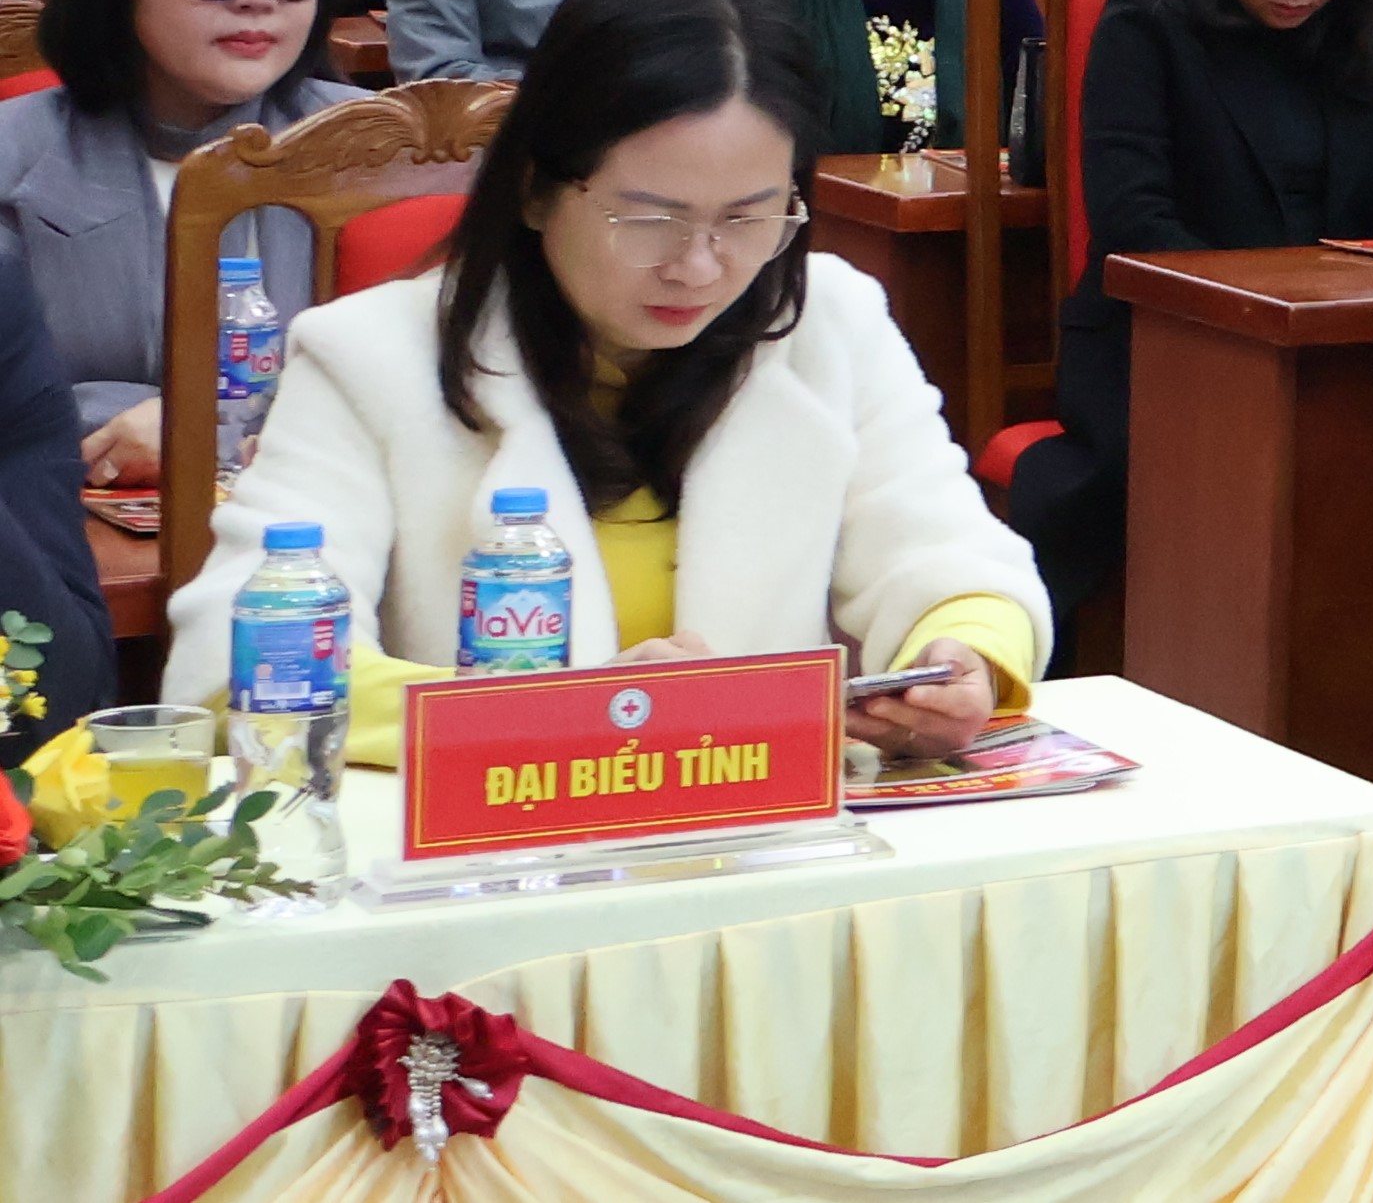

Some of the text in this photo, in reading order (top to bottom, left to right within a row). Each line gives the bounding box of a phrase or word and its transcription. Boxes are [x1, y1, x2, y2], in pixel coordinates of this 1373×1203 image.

[475, 605, 563, 639] laVie
[485, 734, 770, 811] ĐẠI BIỂU TỈNH
